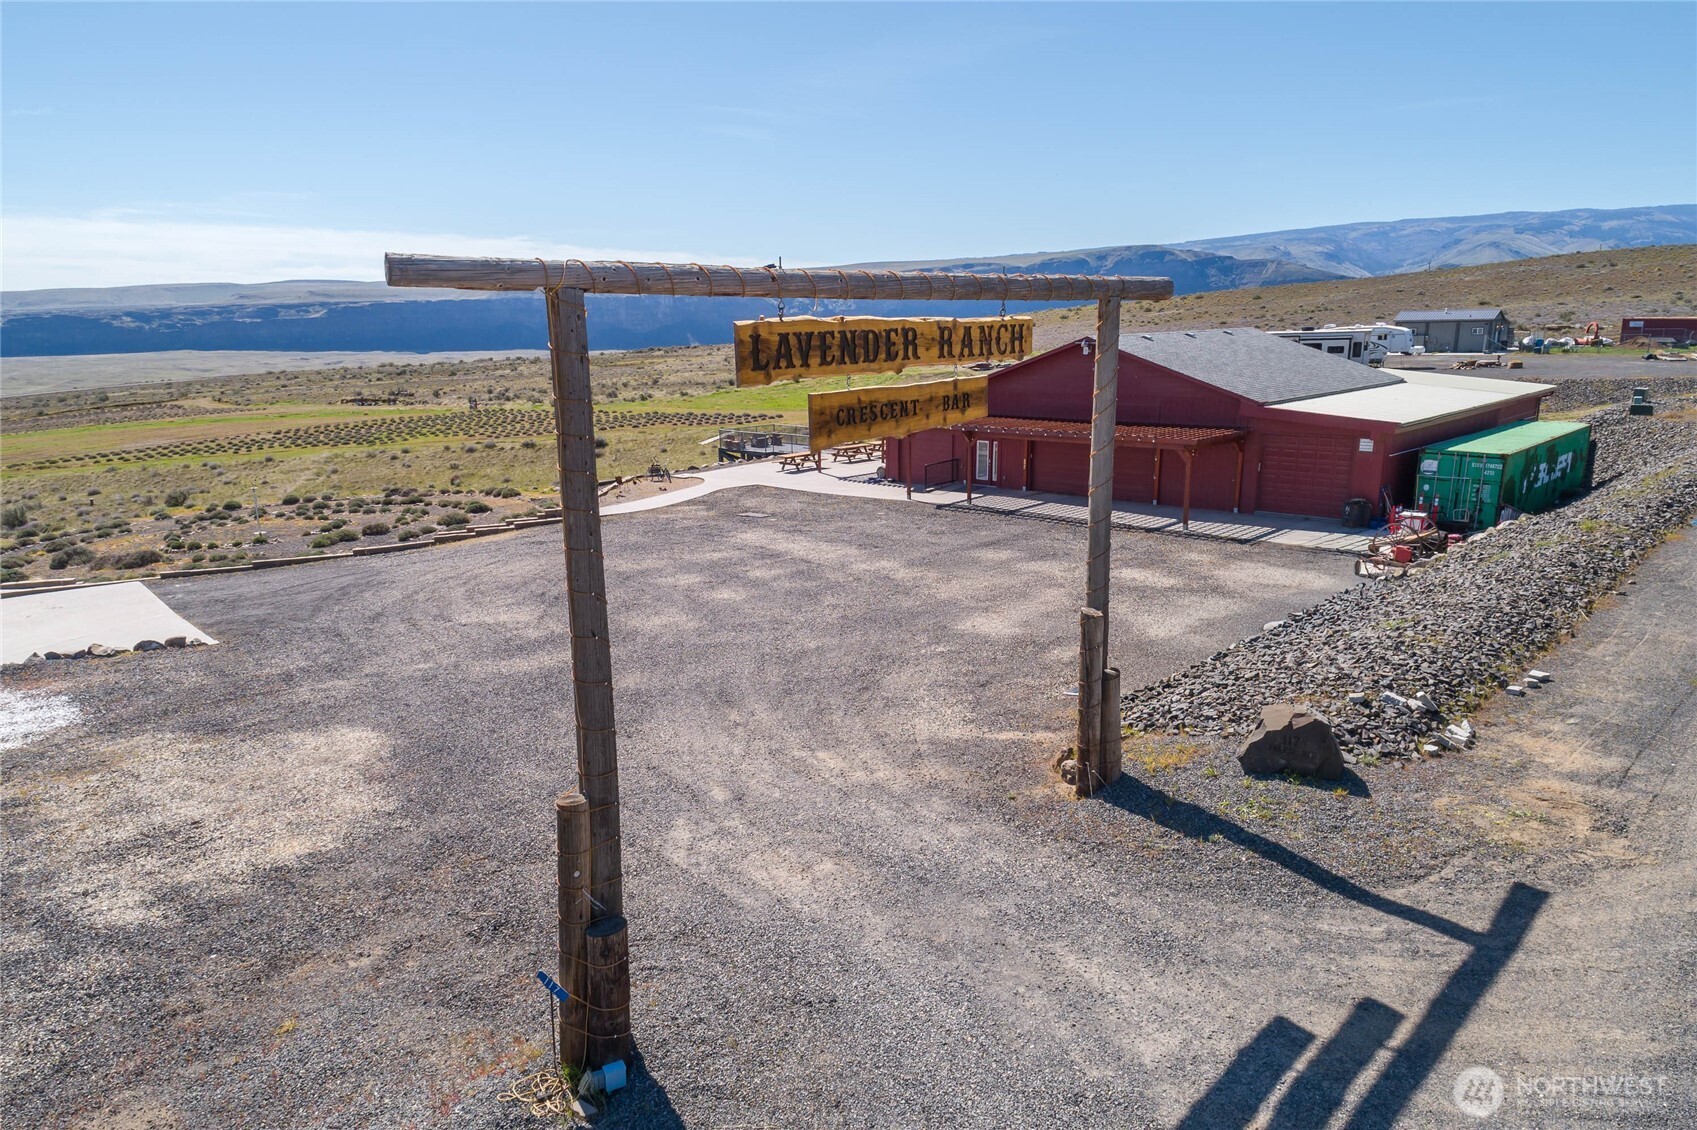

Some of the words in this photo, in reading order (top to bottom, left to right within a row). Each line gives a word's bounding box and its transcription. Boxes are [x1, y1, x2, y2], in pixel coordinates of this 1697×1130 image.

[749, 327, 920, 371] LAVENDER
[937, 323, 1025, 359] RANCH
[836, 399, 920, 427] CRESCENT
[942, 392, 971, 412] BAR
[544, 978, 560, 993] 117
